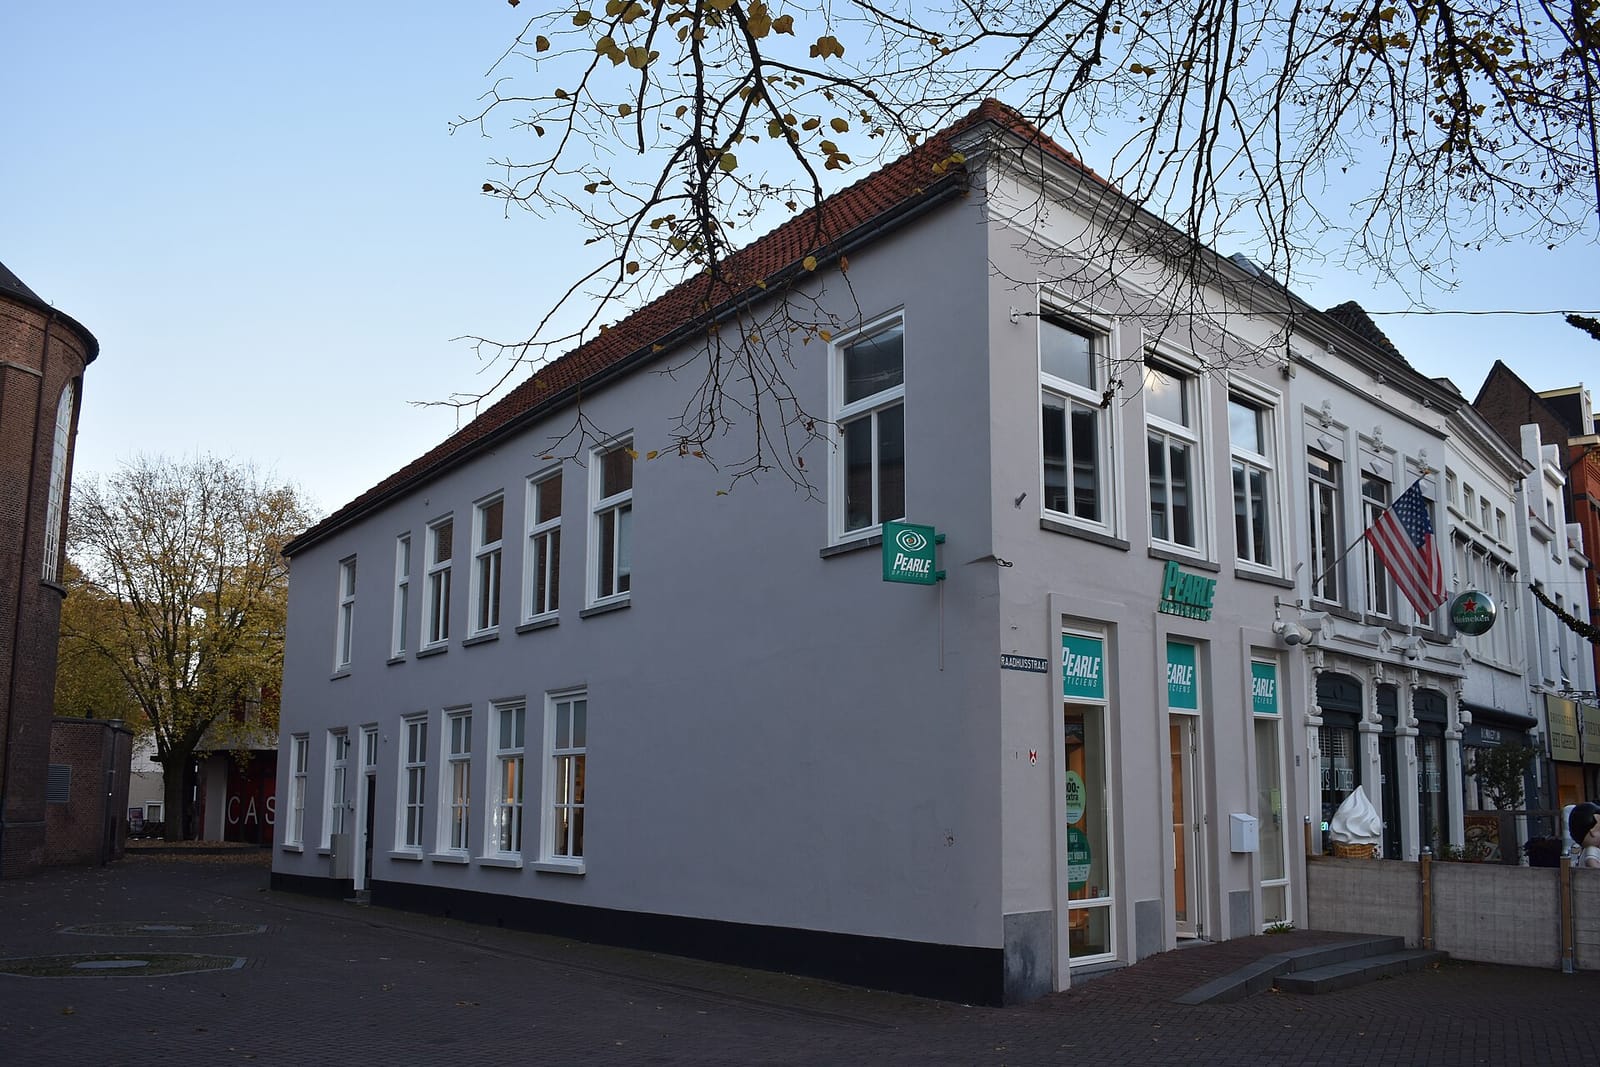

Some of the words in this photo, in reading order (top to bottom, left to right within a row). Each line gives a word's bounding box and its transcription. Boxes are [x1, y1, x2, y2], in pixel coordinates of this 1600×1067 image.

[893, 552, 932, 573] PEARLE
[1162, 560, 1217, 609] PEARLE
[1453, 615, 1490, 624] Heineken
[1001, 656, 1048, 670] RAADHUISSTRAAT
[228, 796, 276, 825] CAS
